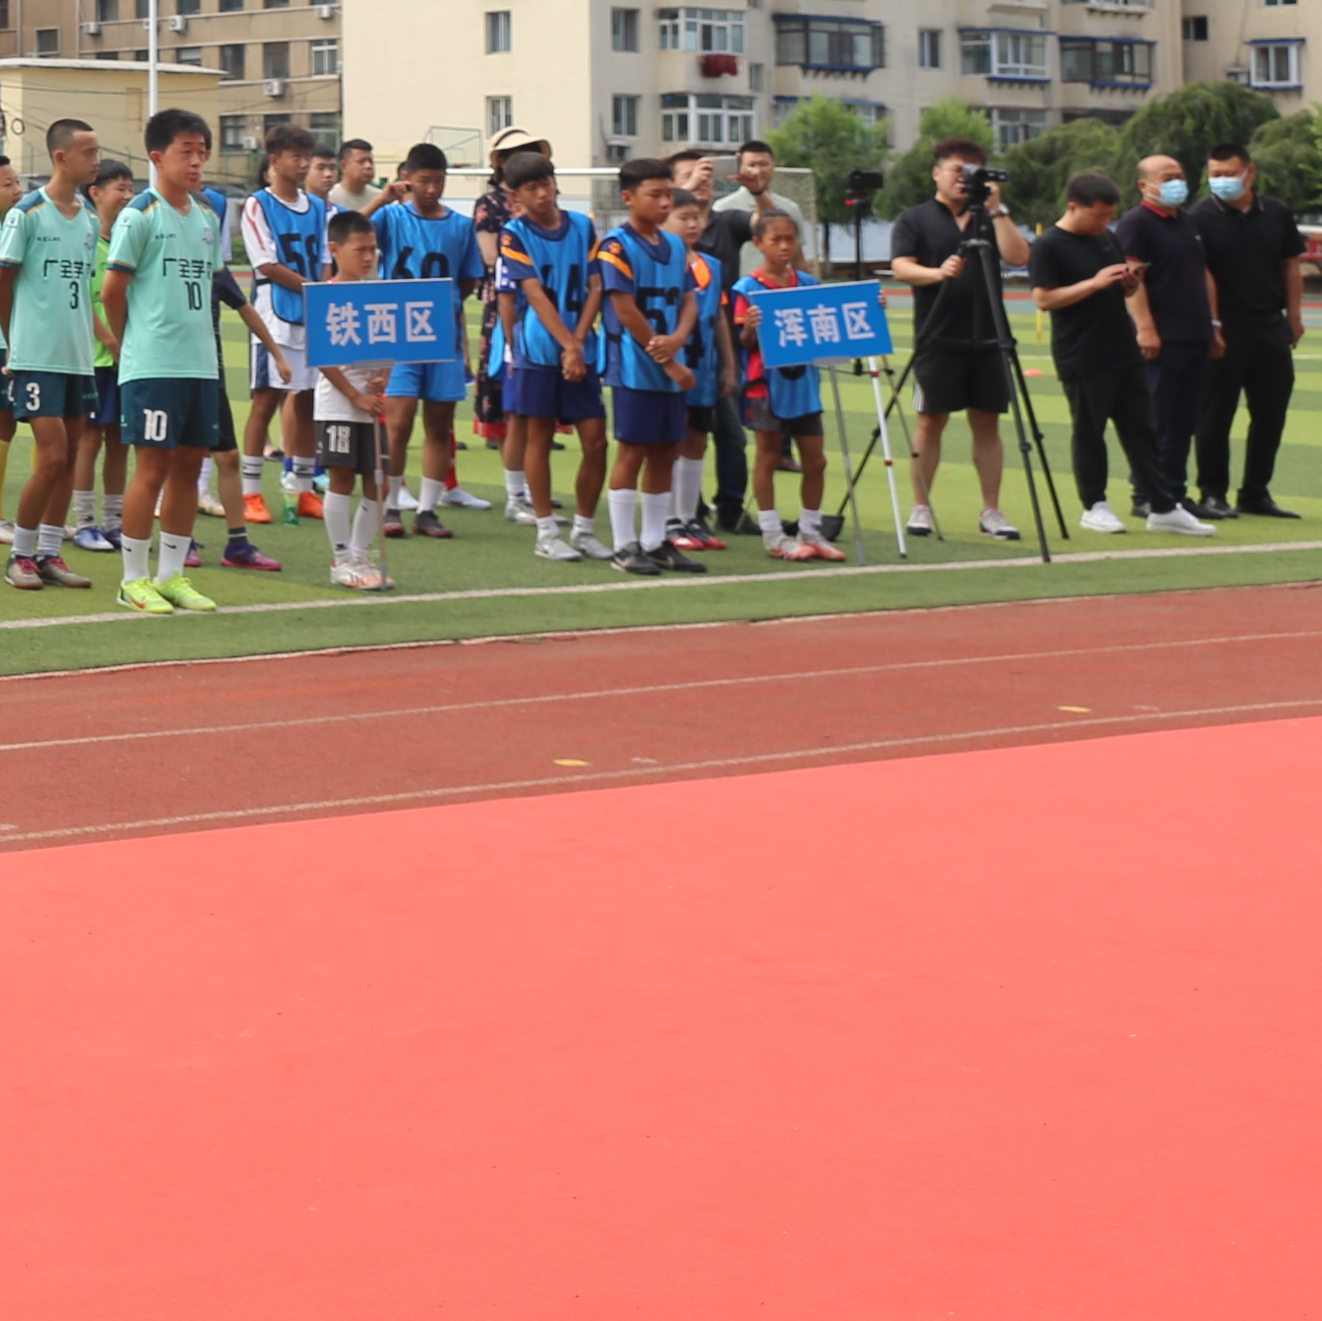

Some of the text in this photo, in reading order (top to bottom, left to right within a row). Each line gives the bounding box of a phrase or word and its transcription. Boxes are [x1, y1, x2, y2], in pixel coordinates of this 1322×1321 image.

[69, 281, 80, 310] 3
[183, 280, 203, 311] 10
[325, 301, 438, 347] 铁西区
[773, 301, 876, 348] 浑南区
[25, 382, 41, 411] 3
[143, 408, 168, 442] 10
